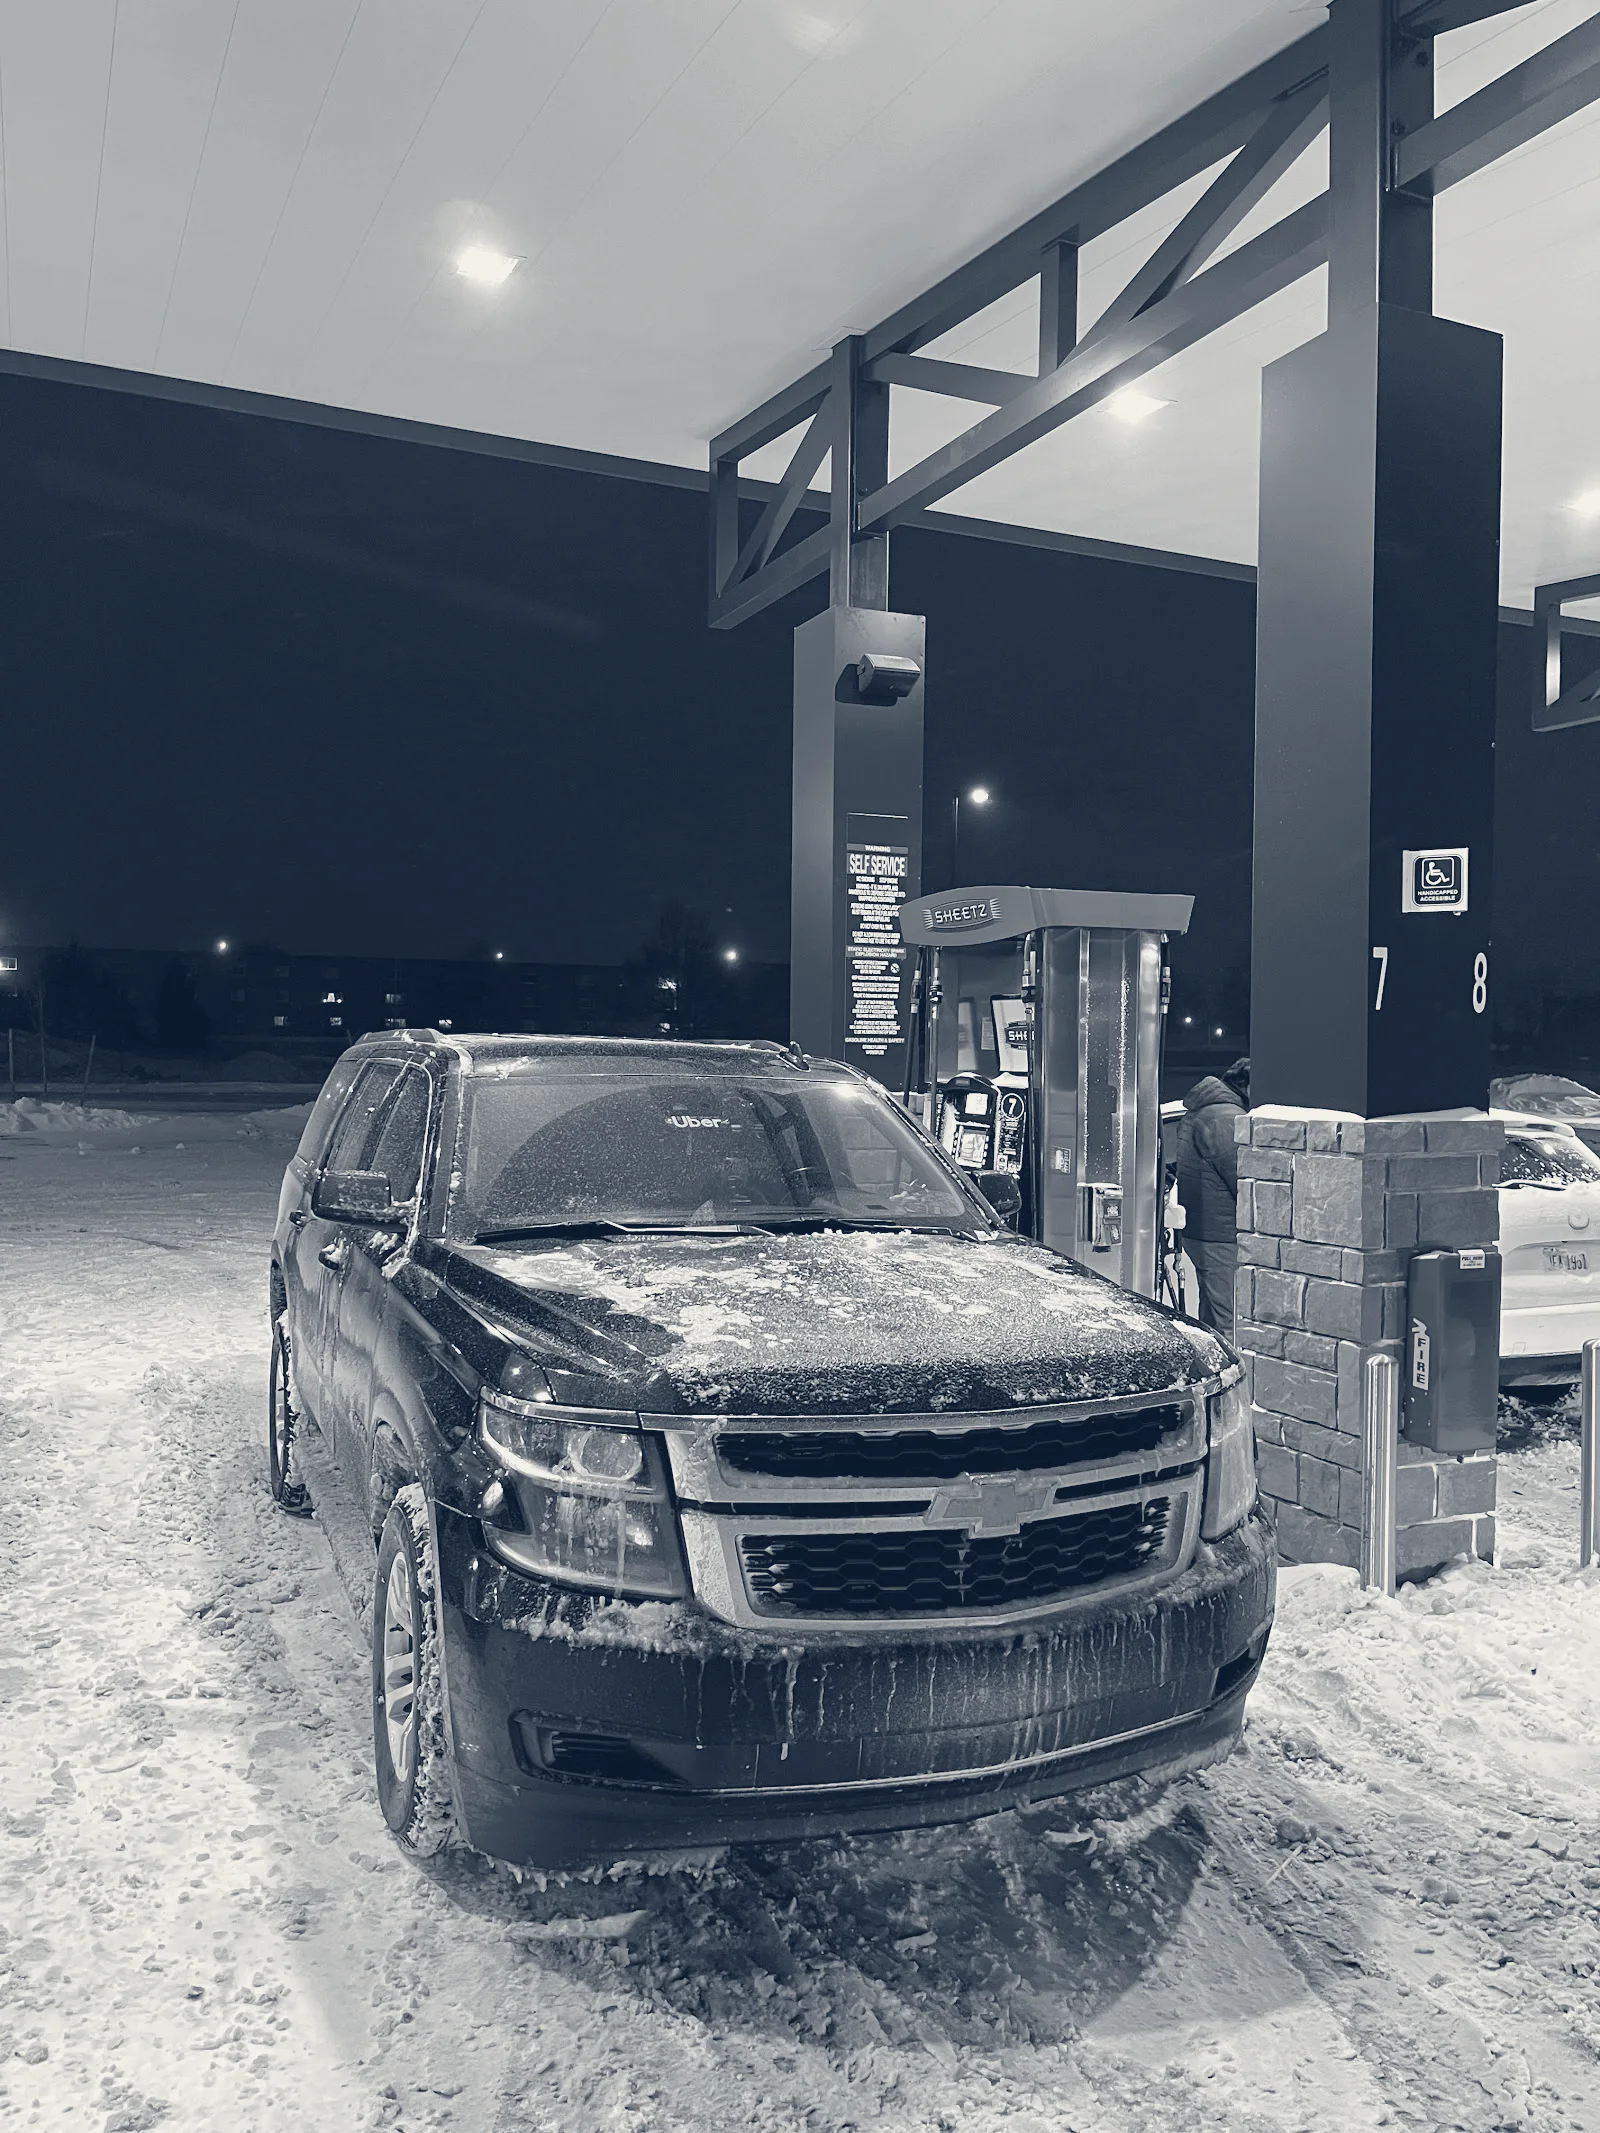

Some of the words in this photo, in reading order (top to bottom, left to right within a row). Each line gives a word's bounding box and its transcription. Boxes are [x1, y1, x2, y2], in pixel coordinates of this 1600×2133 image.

[849, 853, 870, 874] SELF
[871, 855, 905, 877] SERVICE
[935, 904, 988, 923] SHEETZ
[1373, 946, 1388, 1011] 7
[1472, 952, 1488, 1013] 8
[1008, 1098, 1017, 1115] 7
[671, 1115, 721, 1128] Uber
[1416, 1338, 1426, 1384] FIRE
